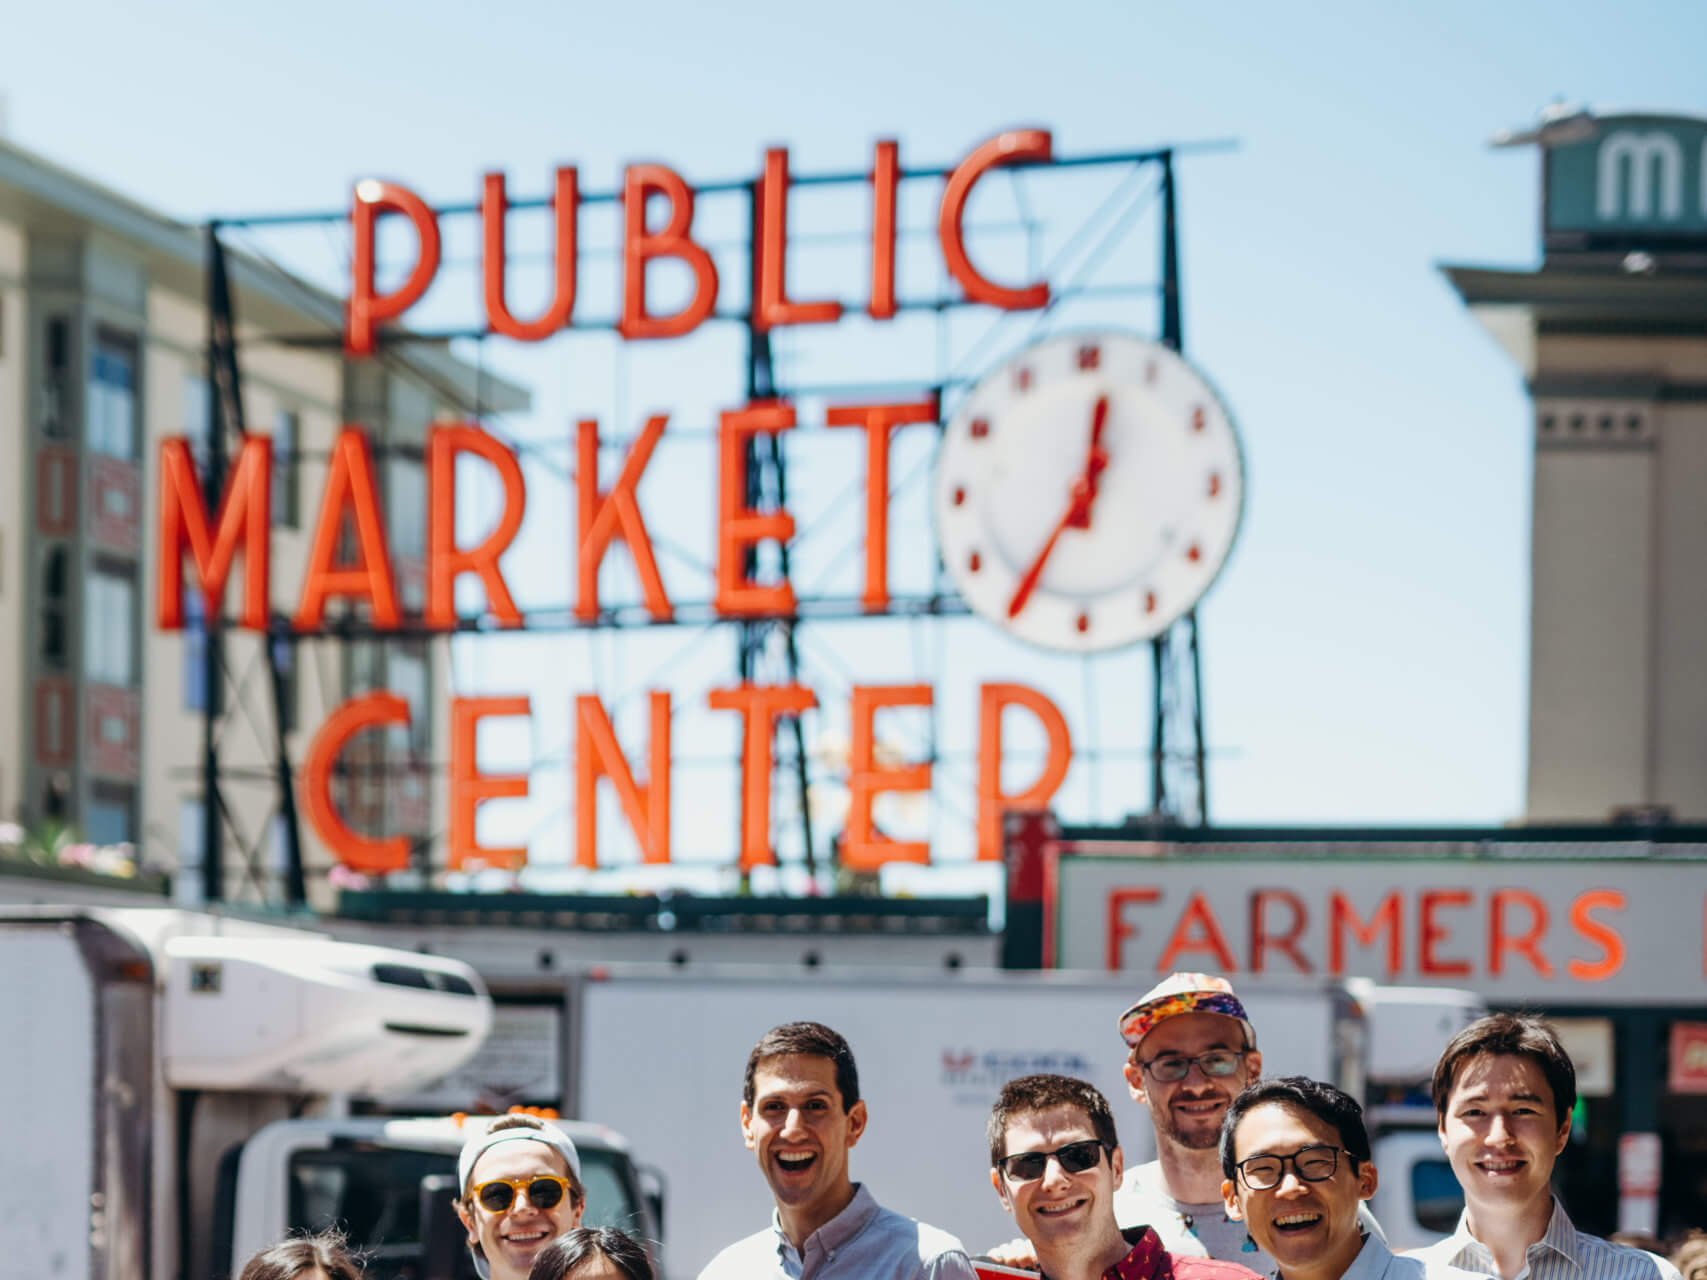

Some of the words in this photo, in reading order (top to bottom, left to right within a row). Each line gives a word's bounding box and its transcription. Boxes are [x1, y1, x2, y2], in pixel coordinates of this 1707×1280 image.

[343, 128, 1053, 359] PUBLIC
[1596, 131, 1707, 220] m
[155, 397, 942, 635] MARKET
[298, 680, 1075, 877] CENTER
[1105, 886, 1628, 983] FARMERS
